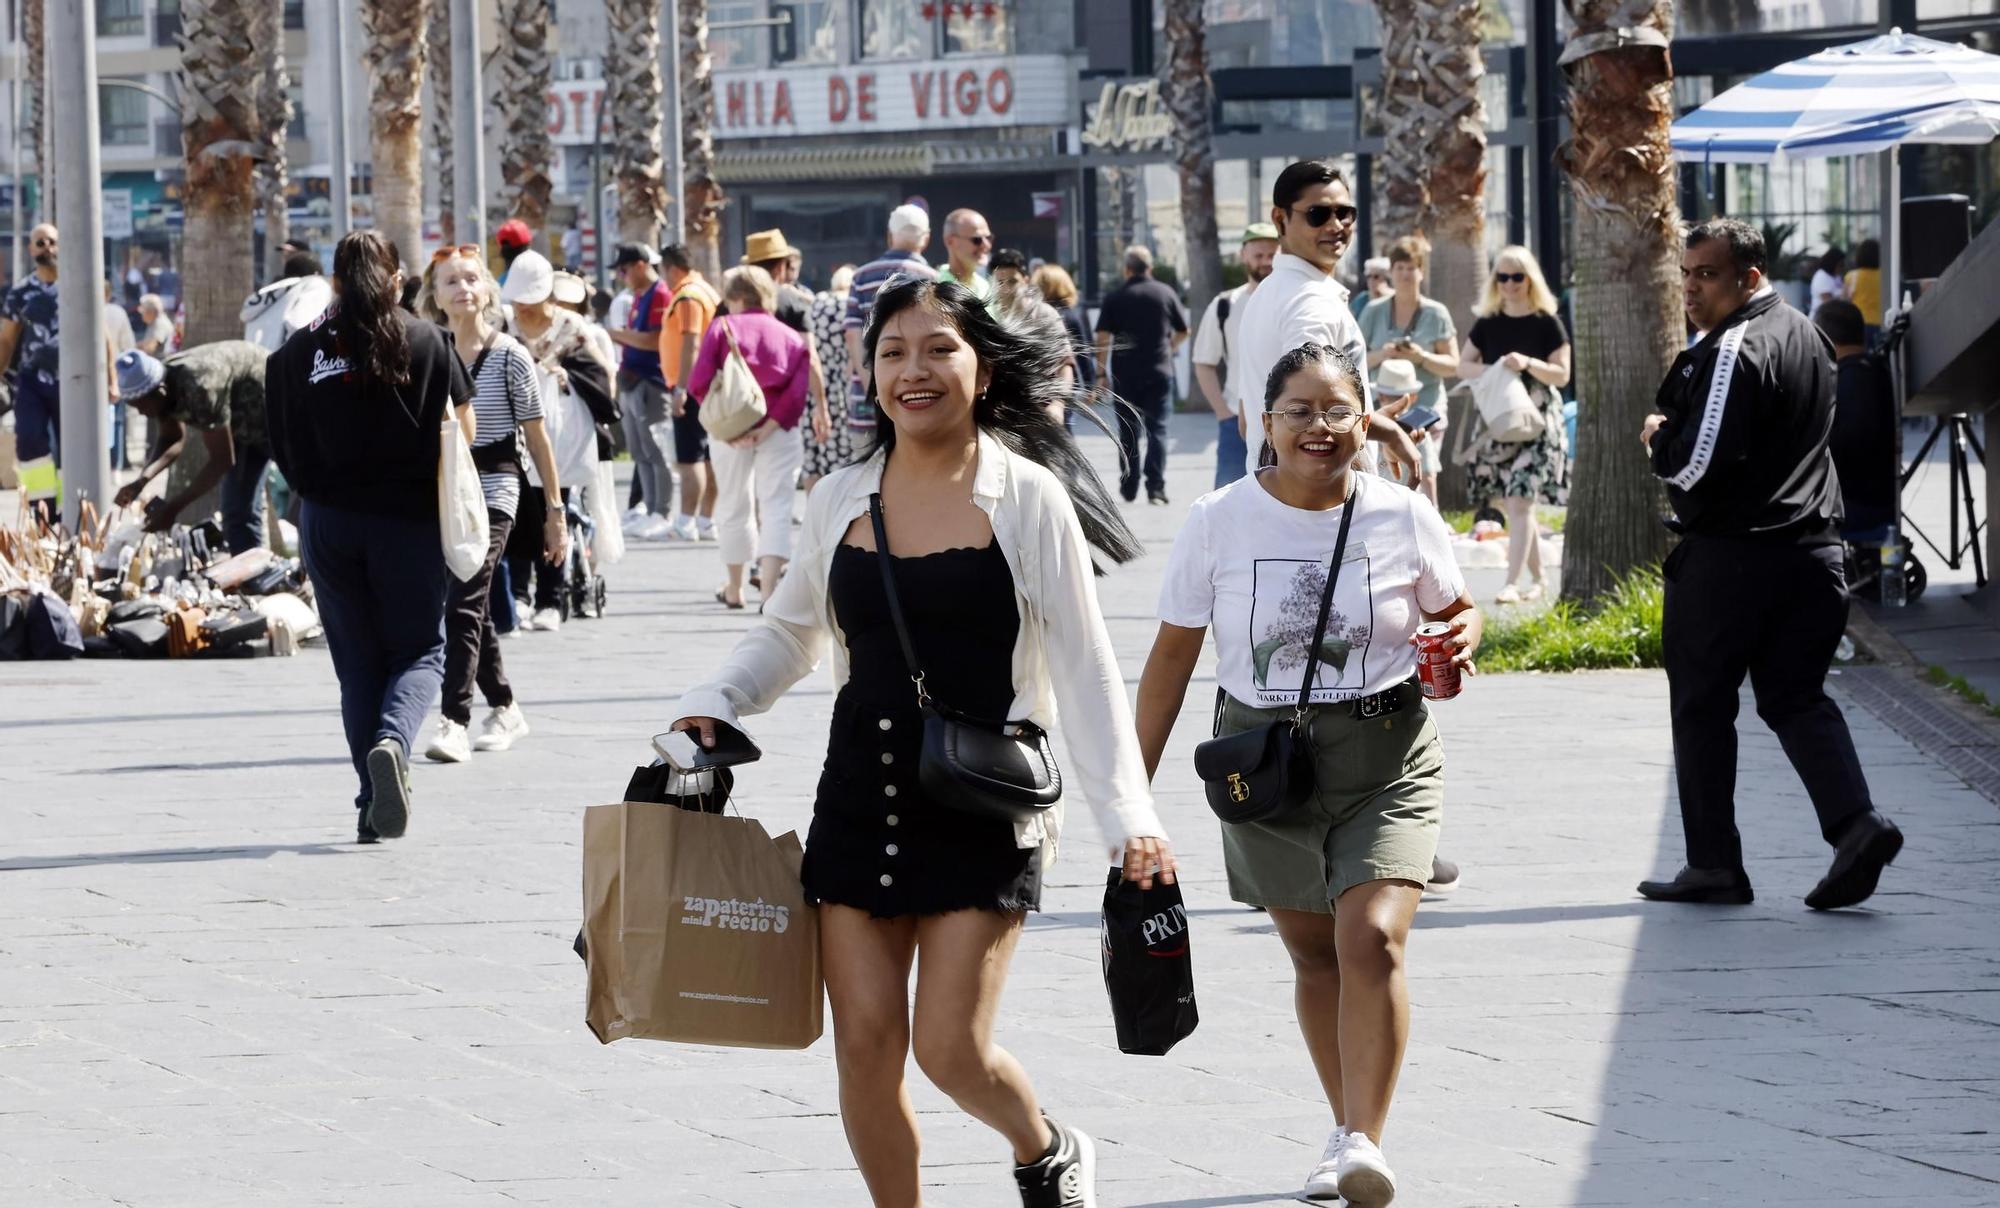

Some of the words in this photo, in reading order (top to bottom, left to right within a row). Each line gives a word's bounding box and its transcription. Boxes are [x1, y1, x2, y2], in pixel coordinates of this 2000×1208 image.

[828, 74, 877, 123] DE
[909, 67, 1013, 119] VIGO
[1256, 693, 1297, 702] MARKET
[1322, 691, 1363, 700] FLEURS
[681, 915, 703, 926] mini
